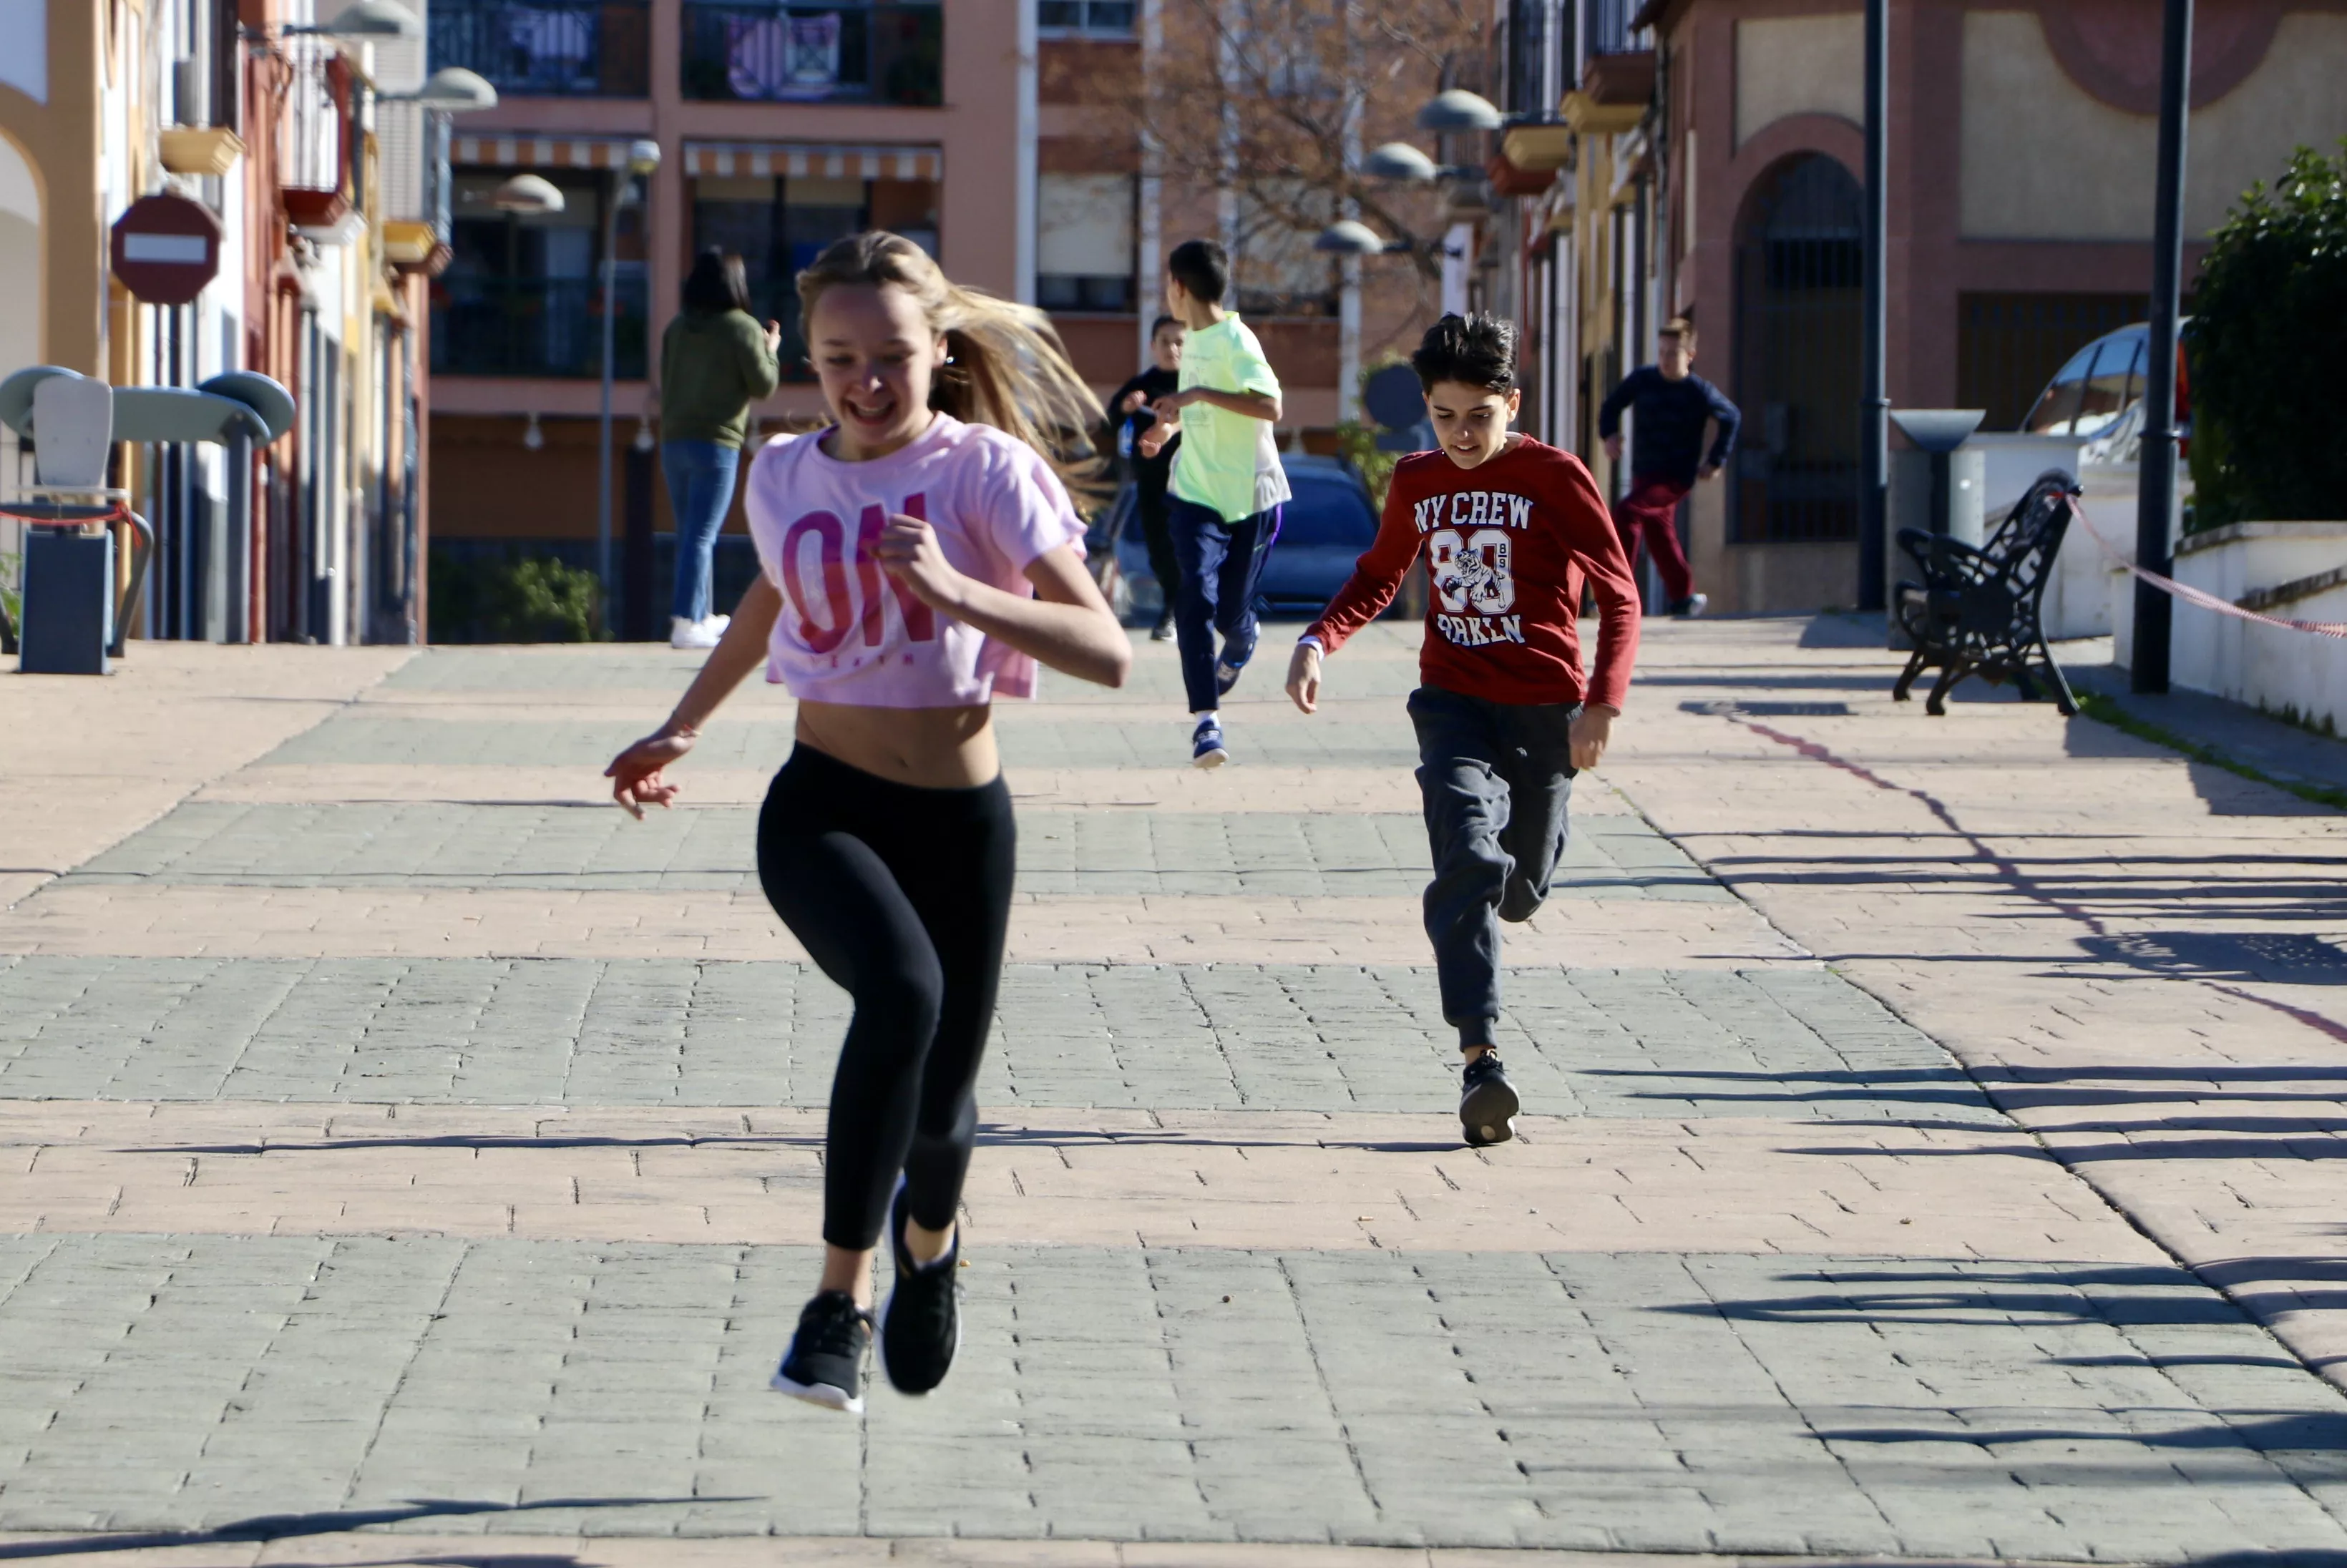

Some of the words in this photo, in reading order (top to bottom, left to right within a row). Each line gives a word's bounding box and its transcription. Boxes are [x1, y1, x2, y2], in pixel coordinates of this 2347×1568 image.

[1414, 494, 1447, 534] NY
[1450, 491, 1533, 529] CREW
[1499, 543, 1506, 554] 8
[1499, 558, 1506, 568] 9
[782, 491, 935, 653] ON
[1430, 528, 1515, 615] 80
